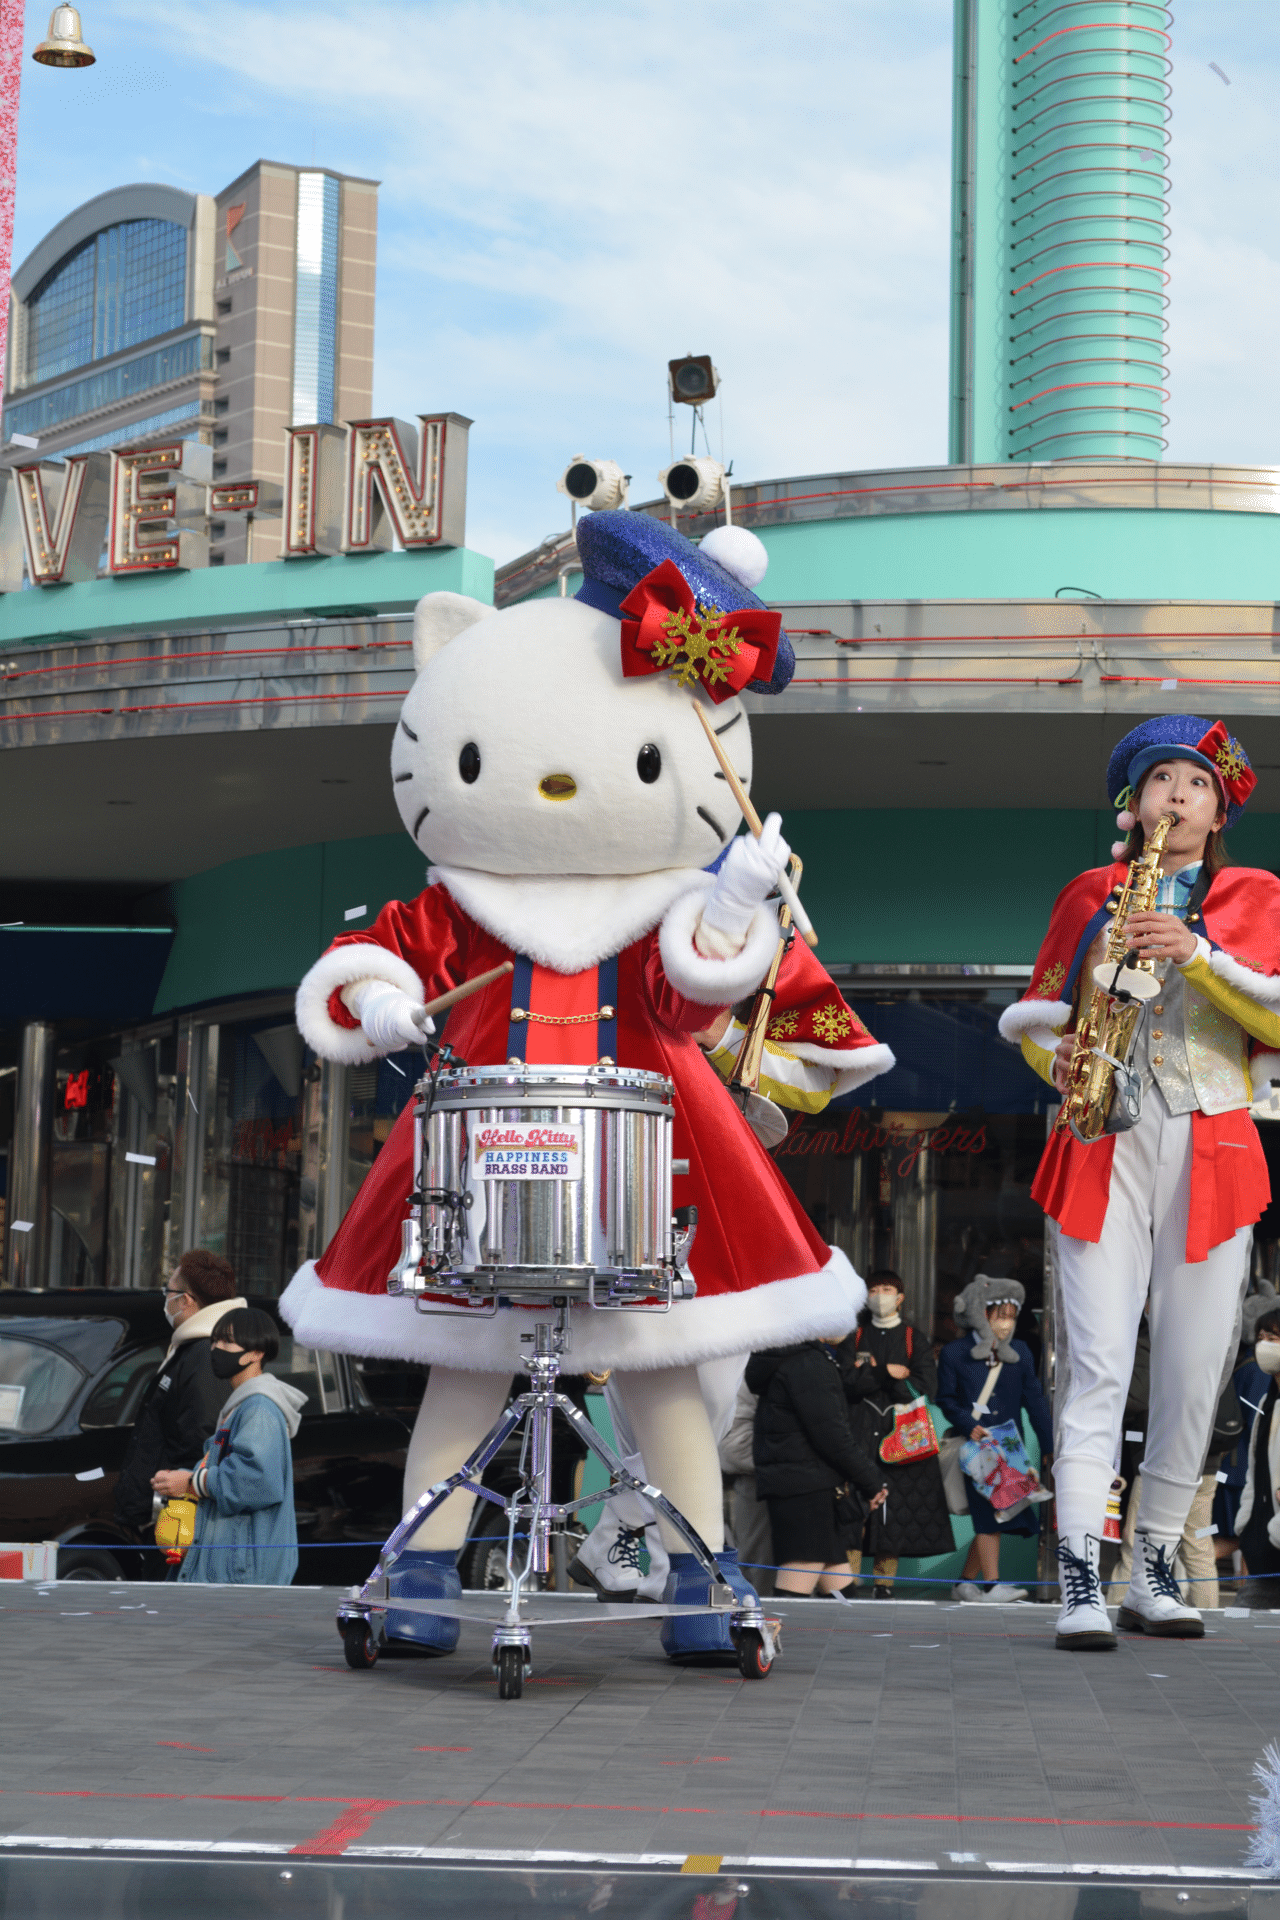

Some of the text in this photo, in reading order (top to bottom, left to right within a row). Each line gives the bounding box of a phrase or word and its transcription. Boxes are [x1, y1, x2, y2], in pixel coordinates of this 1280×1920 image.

[479, 1129, 575, 1148] Hello Kitty
[485, 1152, 568, 1162] HAPPINESS
[485, 1164, 568, 1175] BRASS BAND
